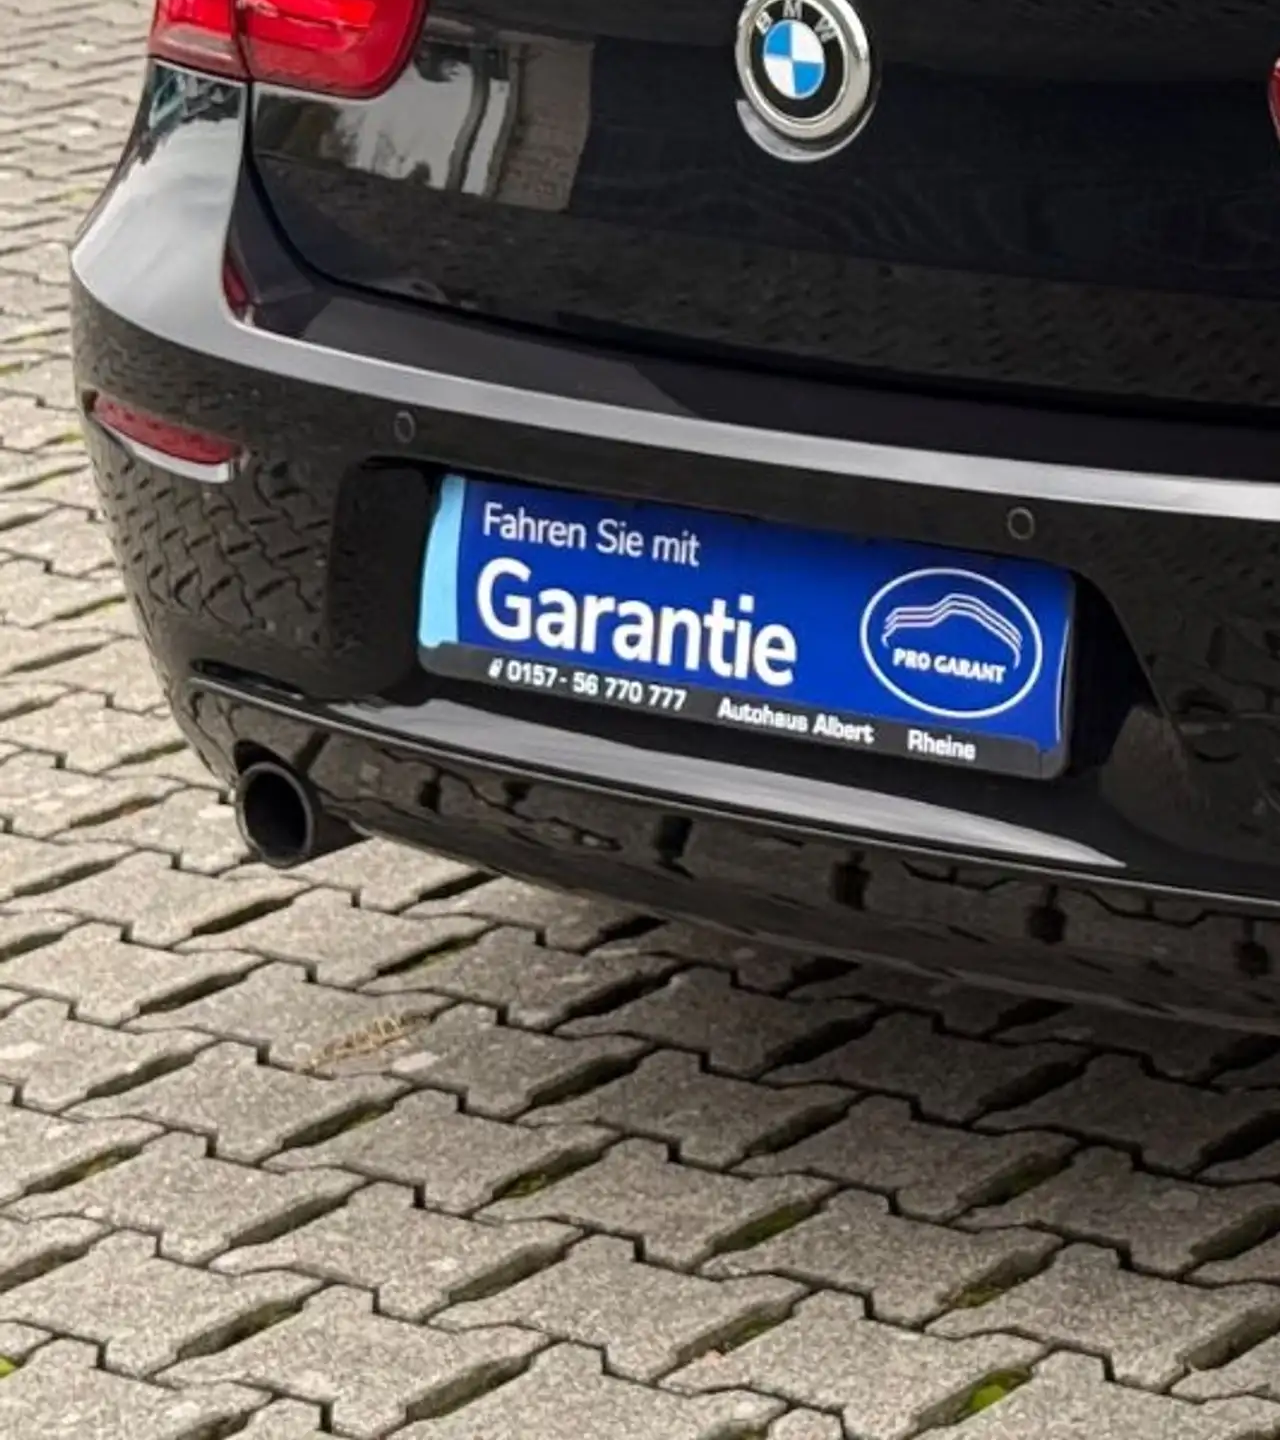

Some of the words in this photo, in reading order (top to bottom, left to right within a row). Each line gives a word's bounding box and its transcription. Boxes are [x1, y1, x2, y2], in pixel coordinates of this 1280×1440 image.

[483, 501, 587, 550] Fahren
[596, 517, 644, 558] Sie
[652, 529, 701, 567] mit
[476, 557, 798, 687] Garantie
[573, 671, 599, 697] 56
[605, 677, 643, 705] 770
[648, 684, 688, 712] 777
[892, 647, 931, 672] PRO
[934, 654, 1007, 684] GARANT
[717, 696, 809, 734] Autohaus
[812, 712, 876, 745] Albert
[907, 728, 976, 762] Rheine
